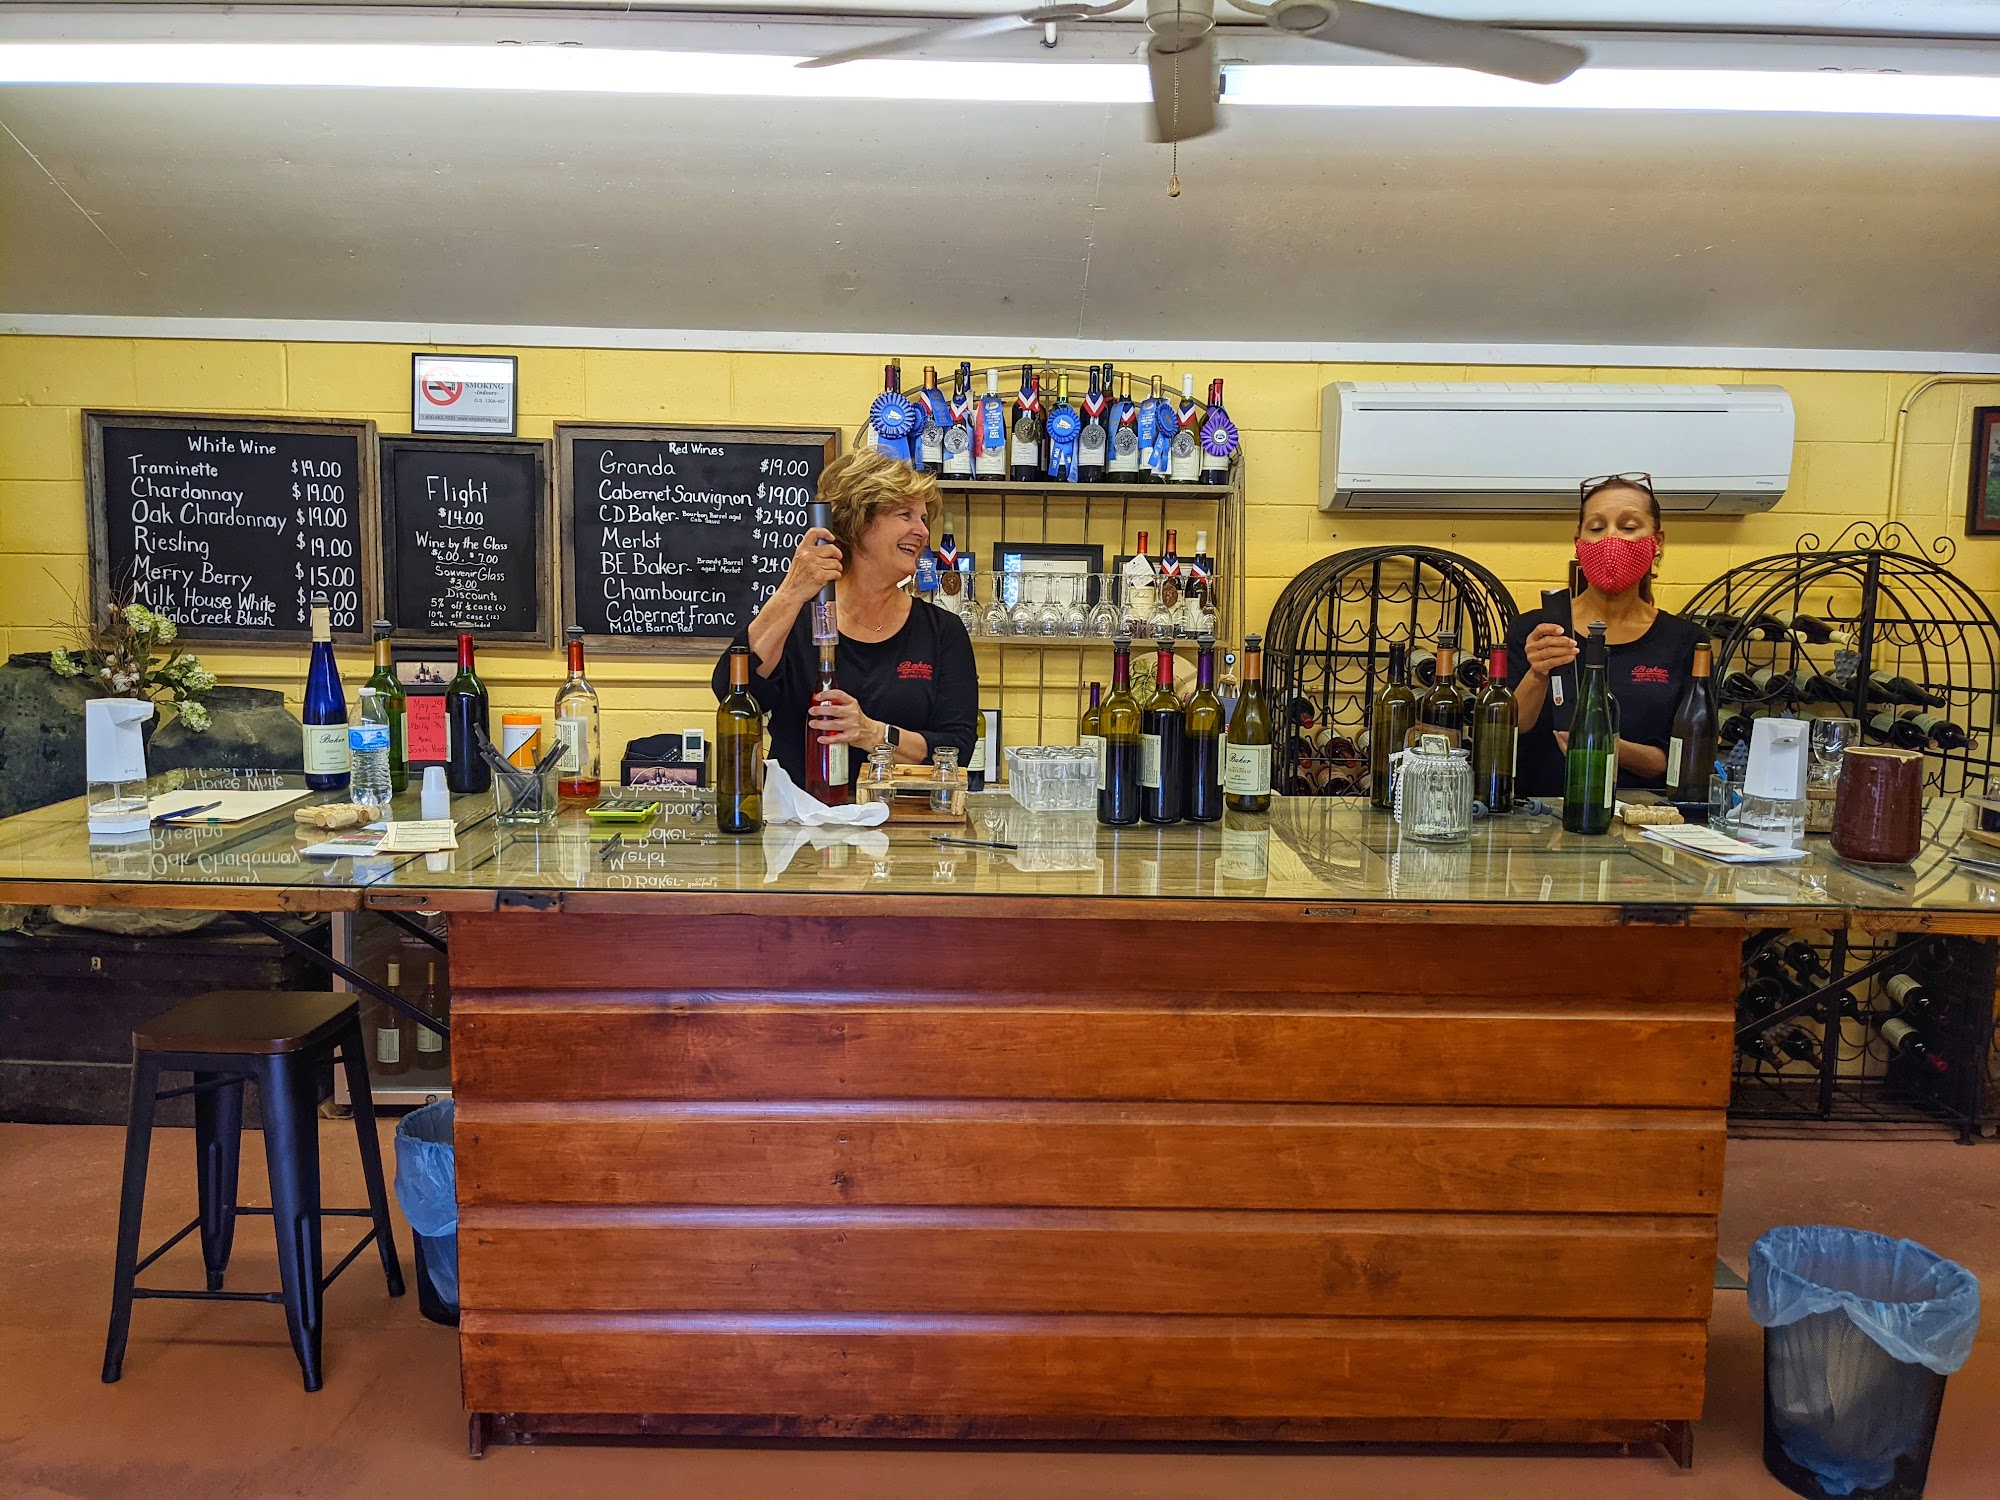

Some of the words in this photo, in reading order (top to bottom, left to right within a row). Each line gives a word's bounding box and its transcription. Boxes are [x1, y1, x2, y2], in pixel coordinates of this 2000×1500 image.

[464, 382, 504, 390] SMOKING
[188, 436, 235, 453] White
[240, 439, 276, 454] Wine
[668, 442, 688, 454] Red
[690, 444, 724, 456] Wines
[128, 454, 218, 478] Traminette
[291, 459, 342, 478] $19.00
[600, 450, 676, 476] Granda
[759, 458, 808, 476] $19.00
[131, 476, 244, 508] Chardonnay
[426, 476, 488, 508] Flight
[598, 479, 671, 502] Cabernet
[671, 485, 753, 510] Sauvignon
[756, 482, 809, 508] $19.00
[132, 500, 173, 524] Oak
[180, 502, 287, 536] Chardonnay
[296, 507, 347, 528] $19.00
[437, 507, 484, 526] $14.00
[600, 504, 626, 524] CD
[682, 510, 708, 518] Bourbon
[709, 512, 728, 520] Barrel
[754, 508, 808, 526] $24.00
[134, 526, 210, 560] Riesling
[416, 531, 446, 548] Wine
[448, 538, 460, 552] by
[462, 536, 479, 550] the
[483, 536, 508, 550] Glass
[601, 527, 662, 549] Merlot
[132, 554, 194, 588] Merry
[199, 562, 252, 592] Berry
[600, 552, 626, 575] BE
[696, 557, 721, 566] Brandy
[722, 558, 744, 566] Barrel
[751, 554, 792, 574] $24.0
[700, 565, 716, 574] aged
[720, 566, 742, 574] Merlot
[434, 565, 478, 579] Souvenir
[478, 567, 505, 582] Glass
[450, 578, 478, 589] $3.00
[603, 576, 726, 602] Chambourcin
[132, 580, 176, 606] Milk
[184, 588, 232, 610] House
[238, 592, 276, 614] White
[445, 588, 498, 601] Discounts
[428, 610, 444, 618] 10%
[450, 610, 463, 618] off
[430, 598, 444, 608] 5%
[450, 600, 463, 610] off
[494, 604, 506, 612] (6)
[606, 600, 686, 624] Cabernet
[689, 604, 736, 625] Franc
[153, 604, 190, 624] ffalo
[190, 608, 232, 626] Creek
[235, 611, 276, 627] Blush
[610, 623, 643, 634] Mule
[646, 623, 674, 632] Barn
[678, 622, 694, 632] Red
[896, 660, 932, 670] Baker
[1631, 665, 1668, 674] Baker
[414, 699, 428, 712] May
[431, 700, 442, 708] 29
[416, 712, 430, 720] Food
[319, 734, 344, 744] Baker
[1229, 752, 1251, 764] Baker
